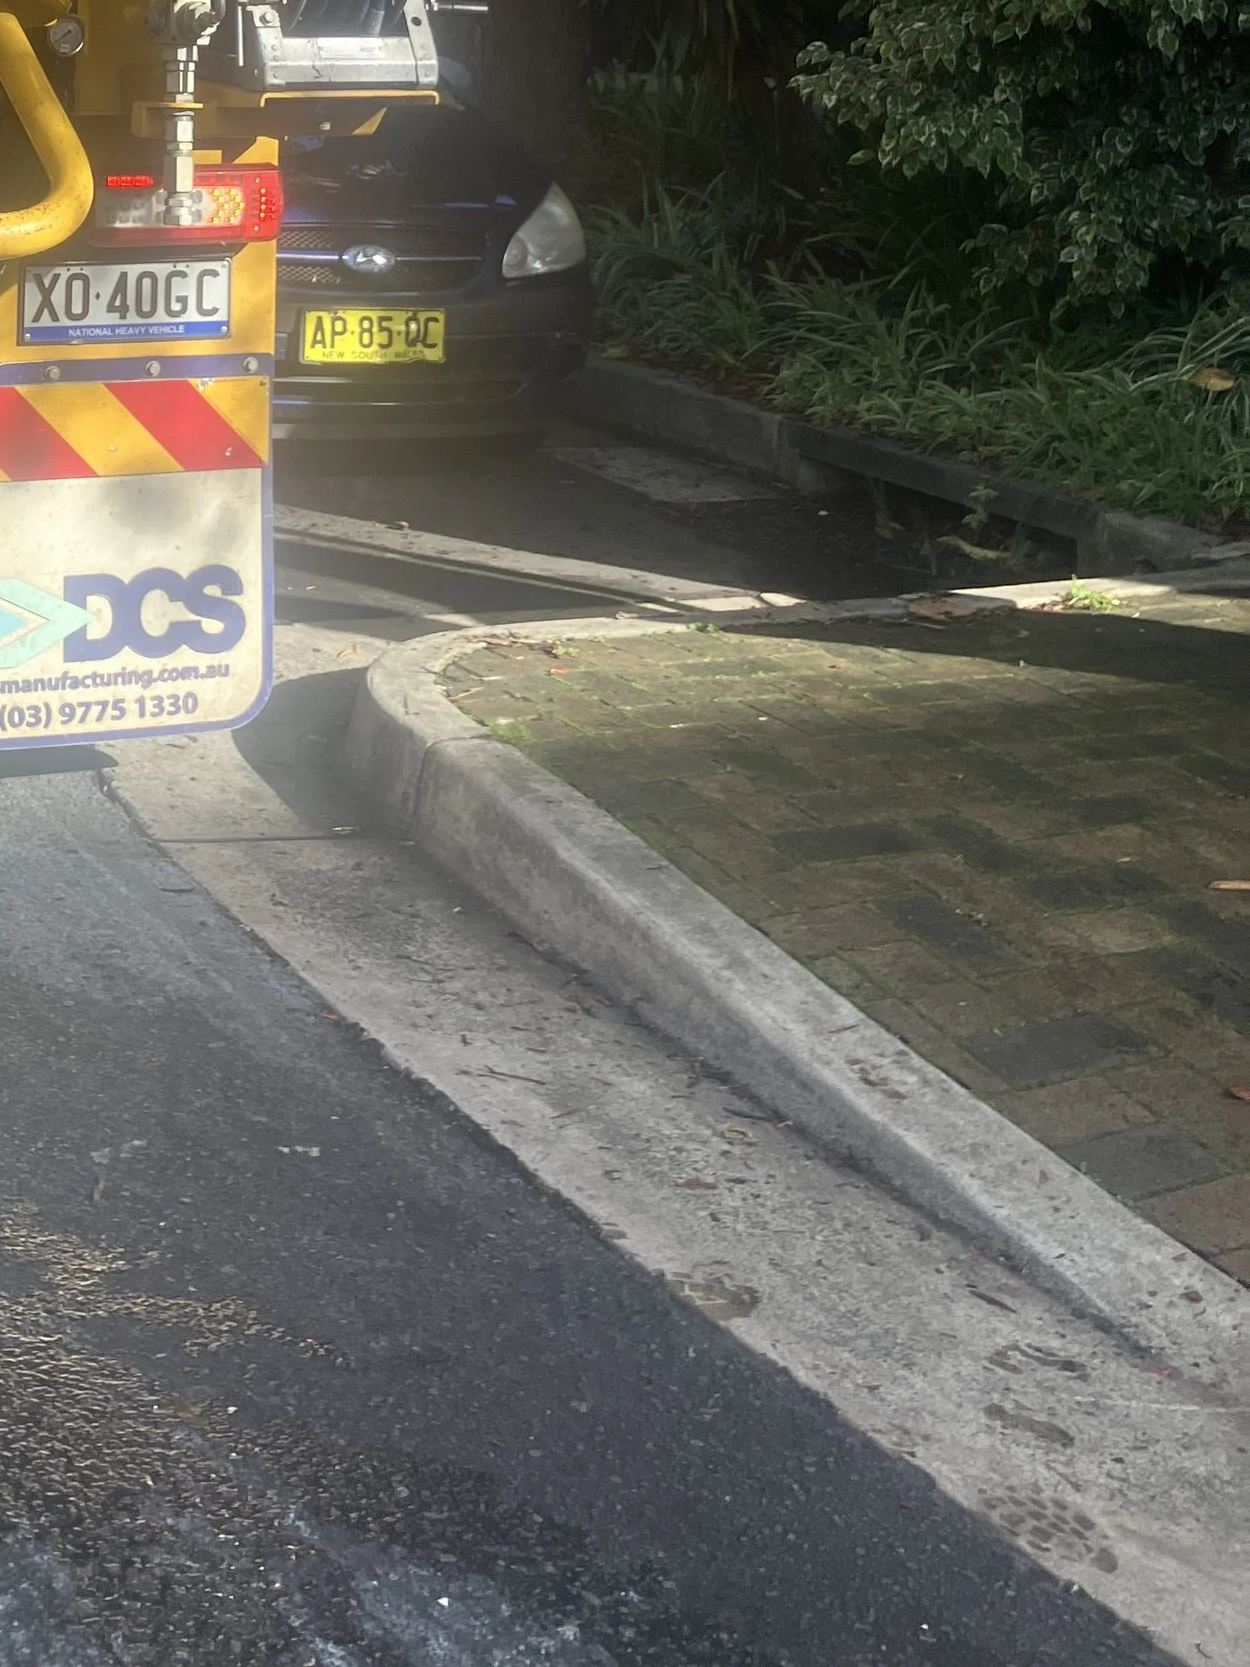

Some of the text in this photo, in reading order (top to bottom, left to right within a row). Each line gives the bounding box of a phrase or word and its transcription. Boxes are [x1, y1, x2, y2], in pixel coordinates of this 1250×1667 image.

[69, 324, 185, 338] NATIONAL HEAVY VEHICLE
[322, 350, 345, 359] NEW
[63, 564, 246, 663] DCS
[0, 692, 199, 731] (03) 9775 1330
